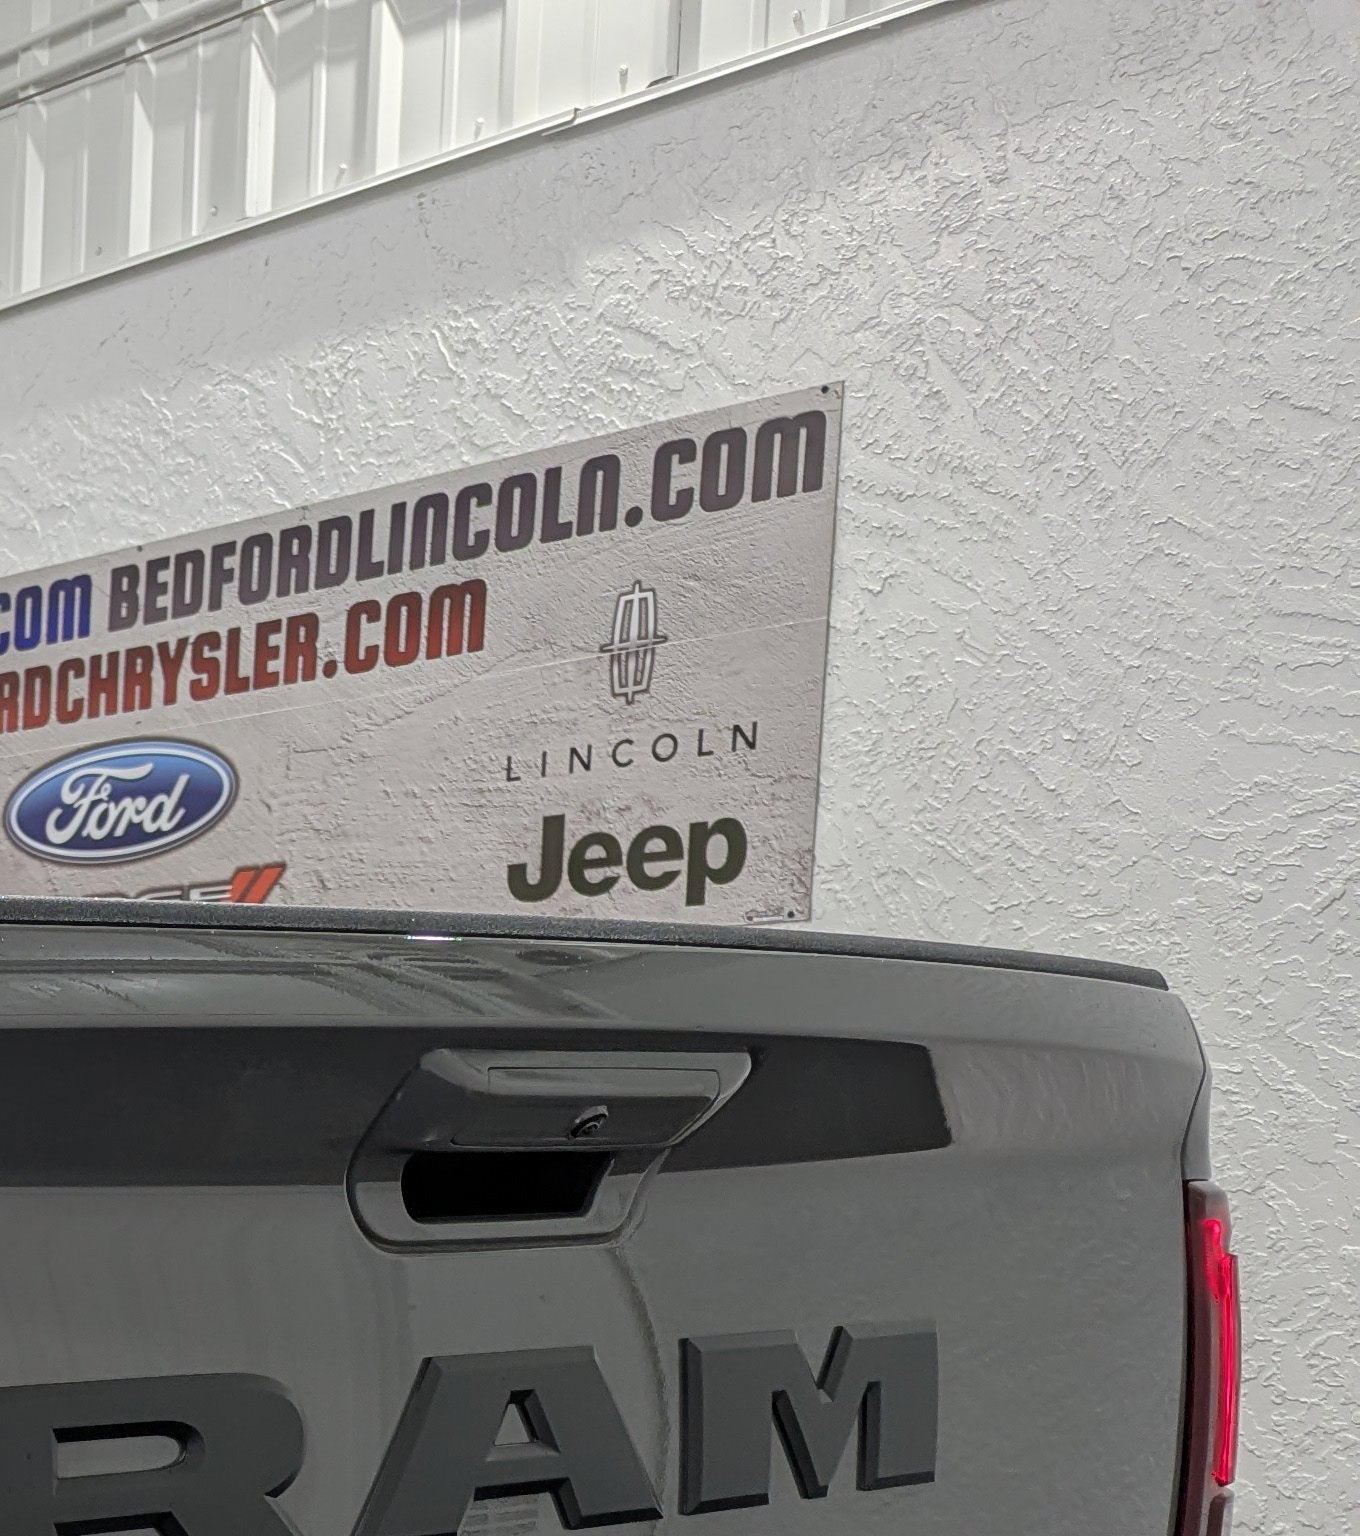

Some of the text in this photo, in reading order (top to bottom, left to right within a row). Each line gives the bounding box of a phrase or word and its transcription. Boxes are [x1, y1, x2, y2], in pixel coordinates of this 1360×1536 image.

[107, 409, 827, 633] BEDFORDLINCOLN.COM
[505, 721, 758, 782] LINCOLN
[45, 762, 190, 845] Ford
[506, 813, 748, 907] Jeep
